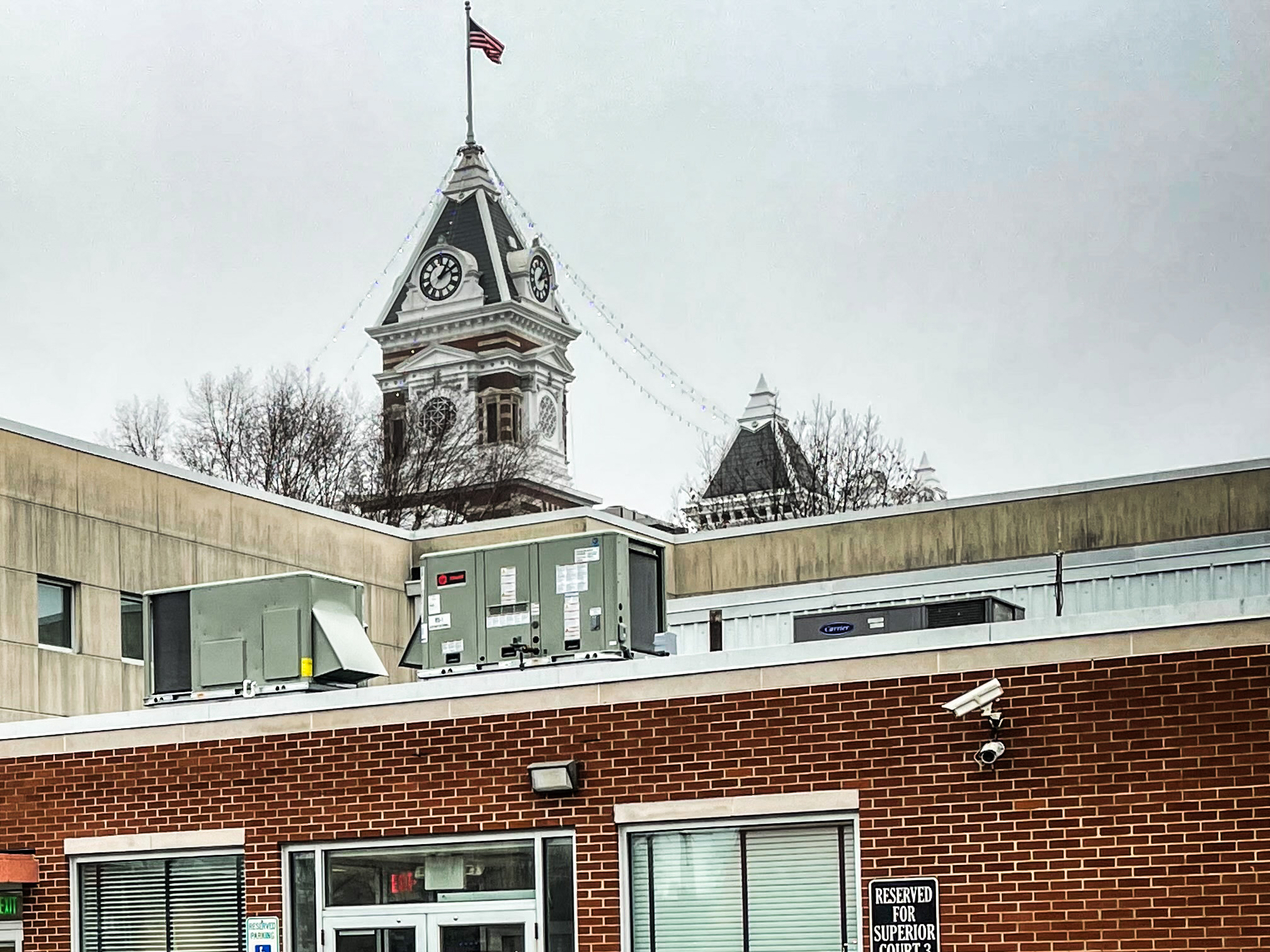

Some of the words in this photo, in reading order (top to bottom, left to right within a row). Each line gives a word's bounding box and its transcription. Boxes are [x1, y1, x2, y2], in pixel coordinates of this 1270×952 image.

[875, 886, 933, 904] RESERVED
[892, 905, 916, 922] FOR
[249, 922, 276, 930] RESERVED
[873, 923, 936, 942] SUPERIOR
[250, 931, 275, 939] PARKING
